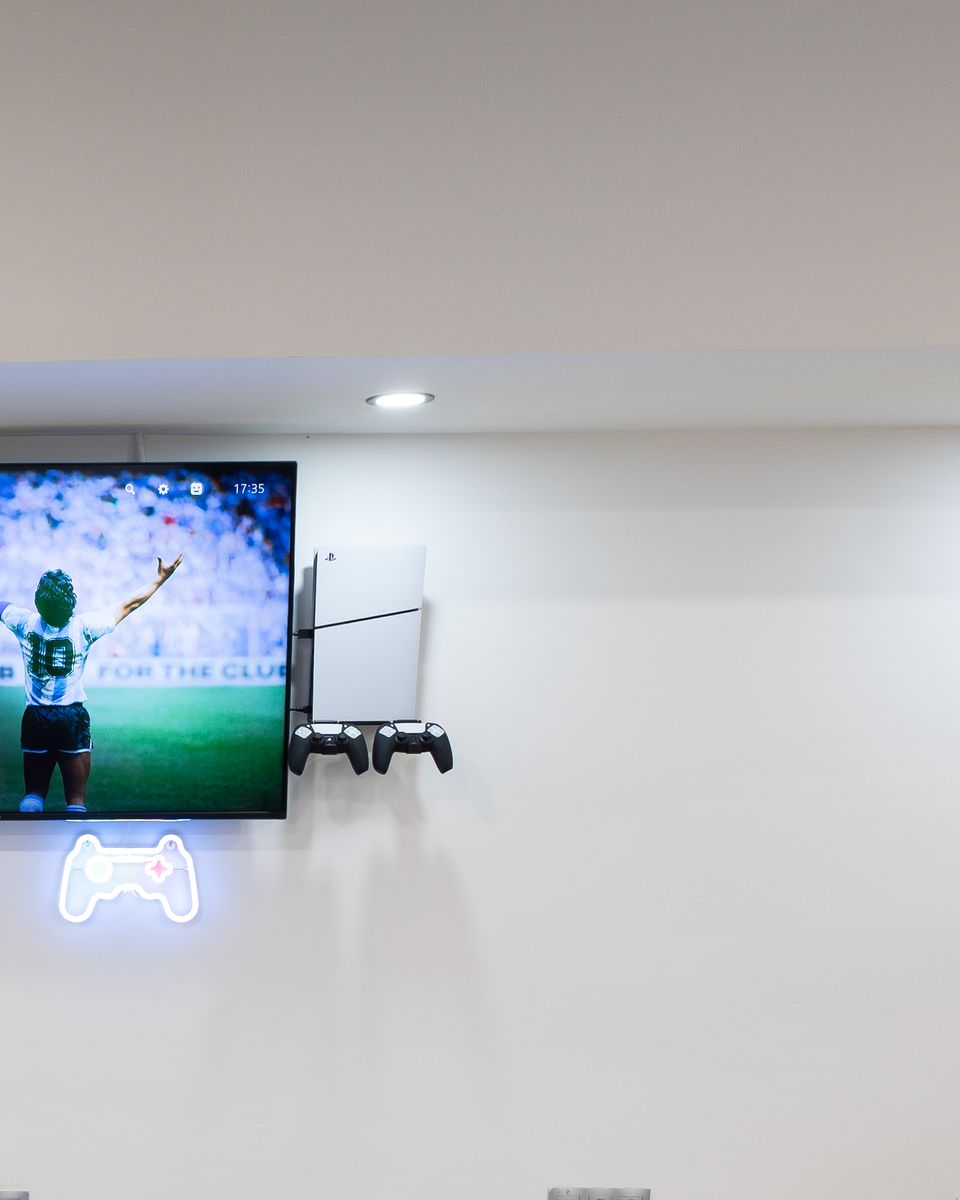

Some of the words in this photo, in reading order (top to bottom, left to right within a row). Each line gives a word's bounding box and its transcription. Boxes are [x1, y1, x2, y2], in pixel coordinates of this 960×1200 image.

[233, 483, 265, 495] 17:35
[98, 663, 152, 679] FOR
[163, 663, 213, 679] THE
